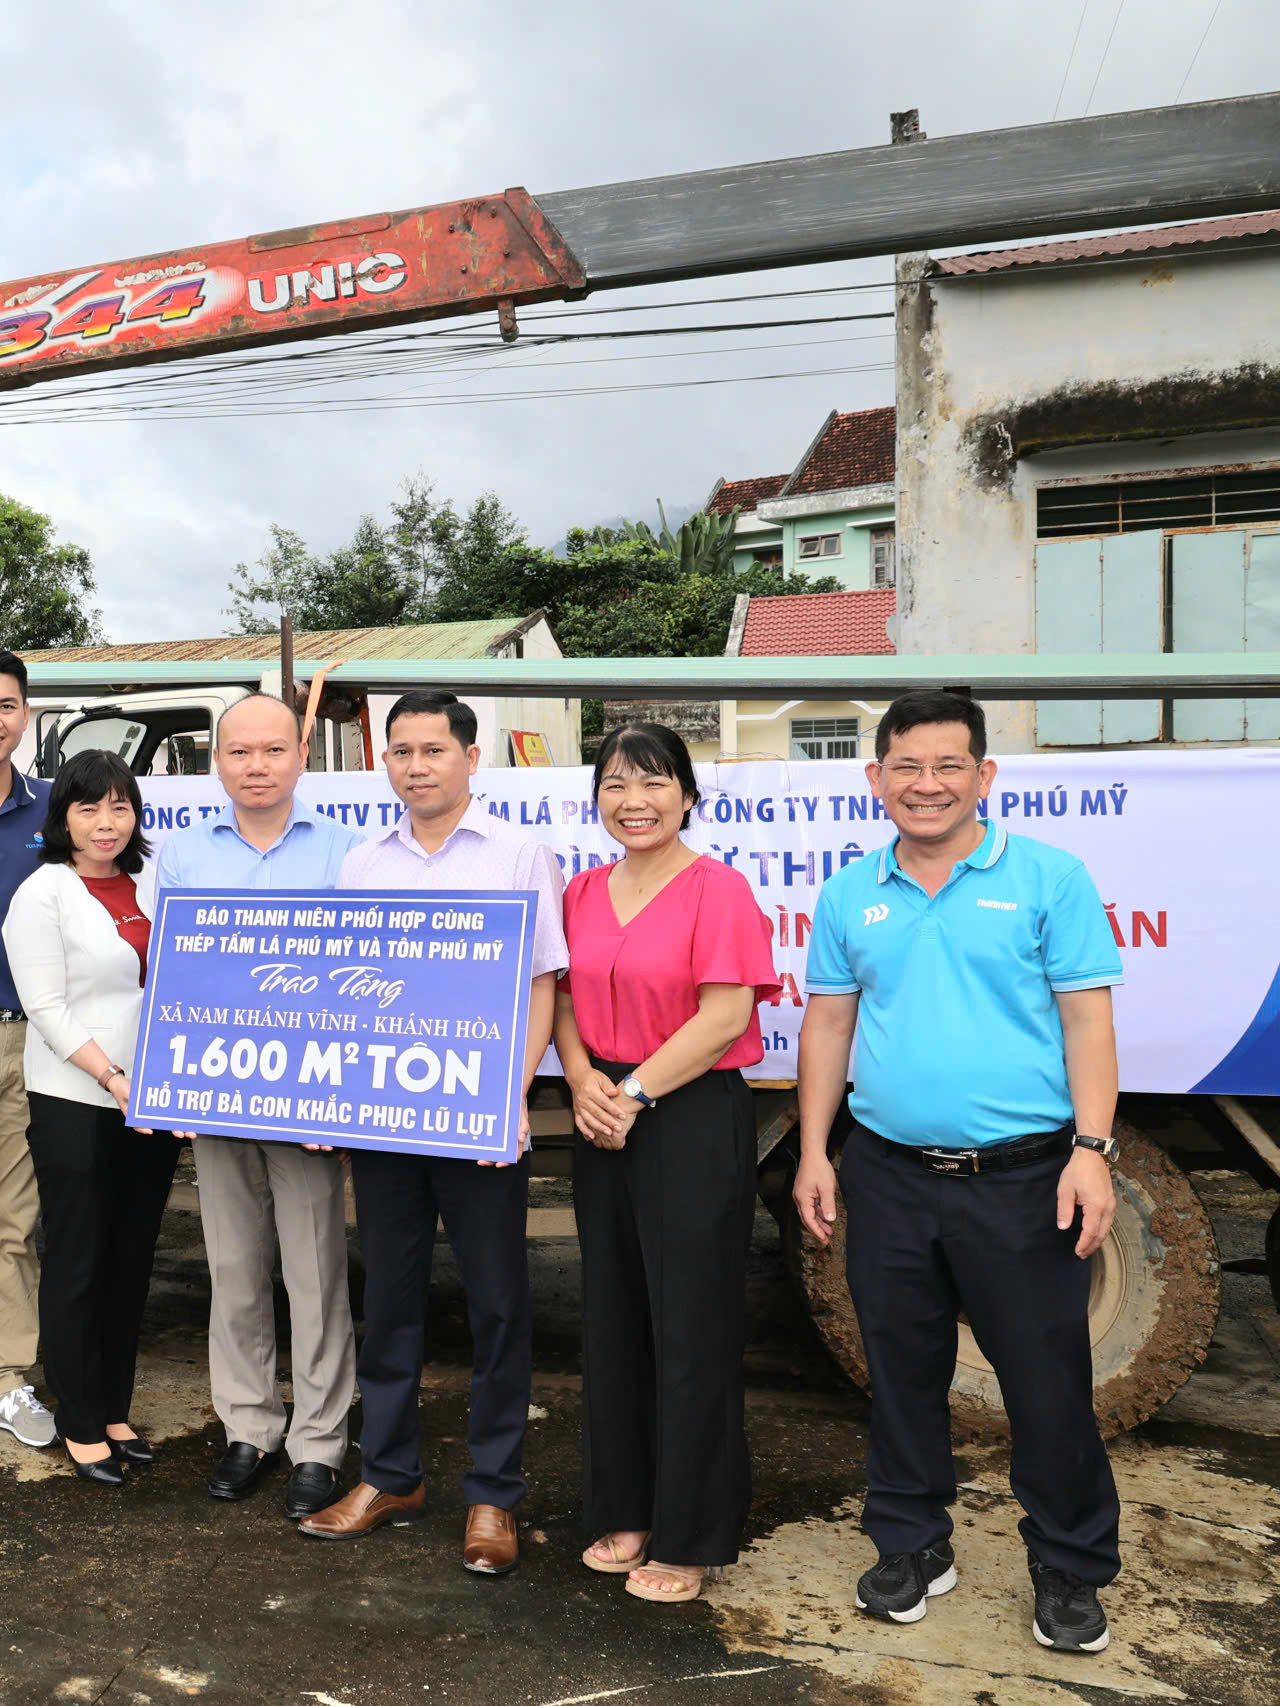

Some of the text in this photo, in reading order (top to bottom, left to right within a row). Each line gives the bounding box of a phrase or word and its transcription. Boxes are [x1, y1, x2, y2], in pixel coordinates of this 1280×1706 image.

[248, 252, 408, 313] UNIC
[141, 803, 191, 830] ÔNG
[520, 796, 552, 825] LÁ
[562, 801, 599, 825] PH
[698, 793, 775, 823] CÔNG
[784, 796, 820, 822] TY
[829, 795, 891, 821] TNH
[1001, 785, 1067, 817] PHÚ
[1080, 782, 1128, 816] MỸ
[196, 905, 484, 933] BÁO THANH NIÊN PHỐI HỢP CÙNG
[175, 931, 504, 961] THÉP TẤM LÁ PHÚ MỸ VÀ TÔN PHÚ MỸ
[250, 963, 406, 1008] Trao Tặng
[158, 1001, 183, 1022] XÃ
[187, 1006, 229, 1025] NAM
[232, 1005, 302, 1029] KHÁNH
[307, 1008, 358, 1032] VĨNH
[373, 1012, 450, 1037] KHÁNH
[455, 1016, 502, 1040] HÒA
[169, 1034, 288, 1082] 1.600
[366, 1041, 482, 1097] TÔN
[145, 1080, 497, 1141] HỖ TRỢ BÀ CON KHẮC PHỤC LŨ LỤT
